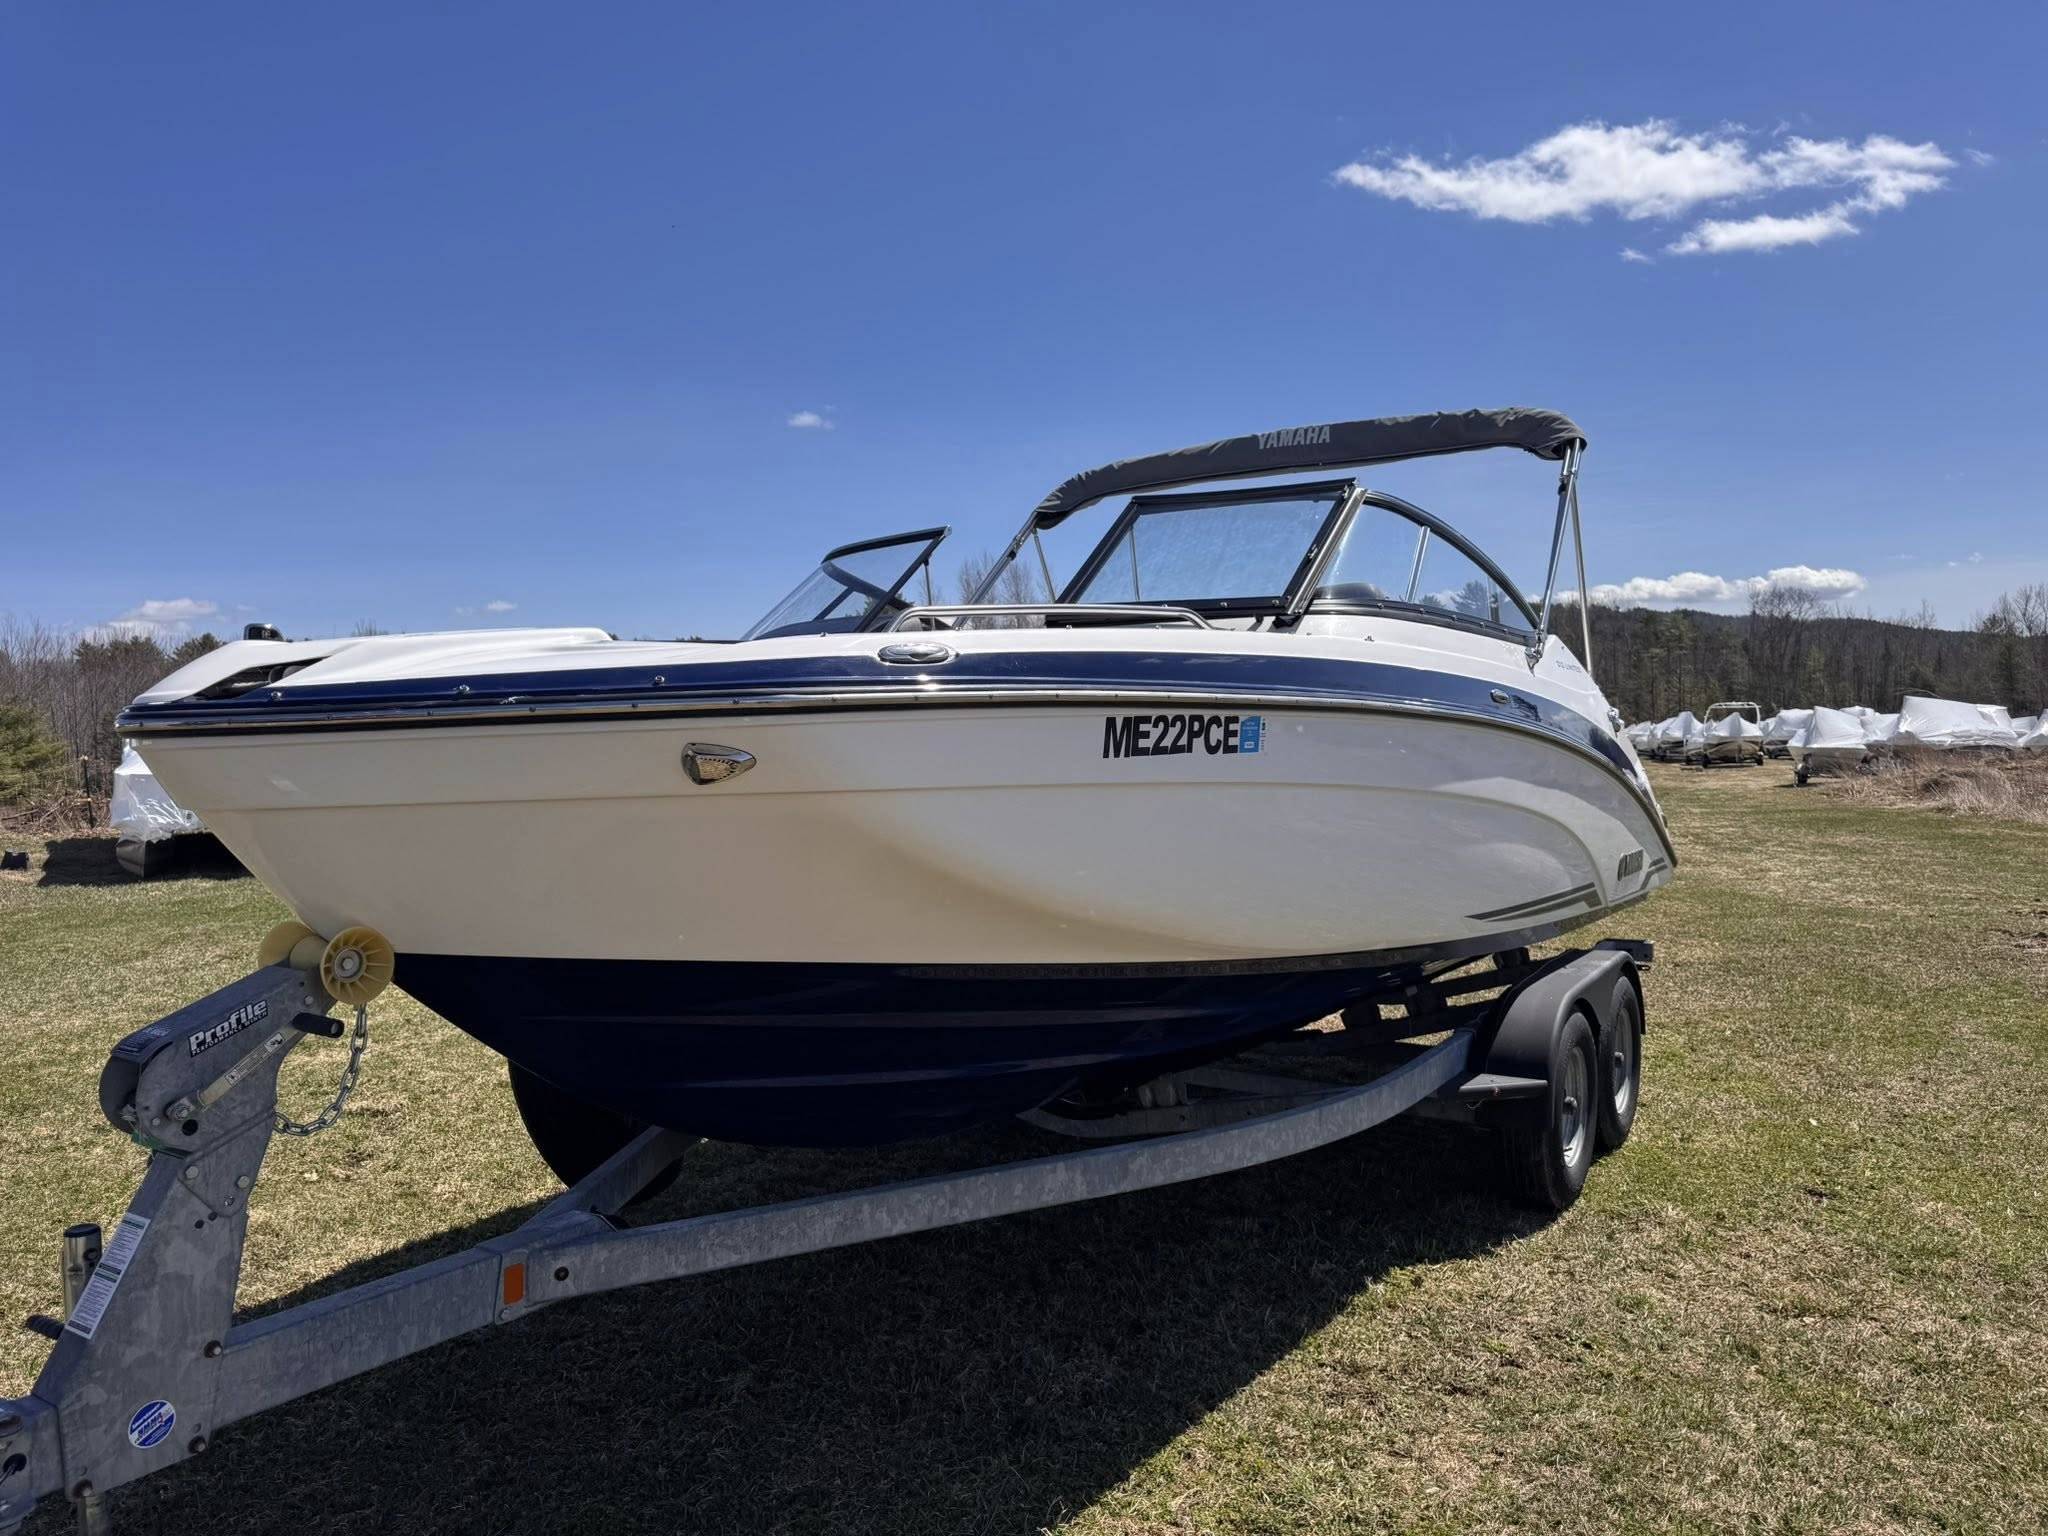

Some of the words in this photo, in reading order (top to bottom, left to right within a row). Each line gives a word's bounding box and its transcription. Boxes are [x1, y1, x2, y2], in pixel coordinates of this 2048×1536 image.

[1258, 425, 1330, 450] YAMAHA
[1103, 714, 1239, 759] ME22PCE
[189, 1000, 267, 1051] Profile
